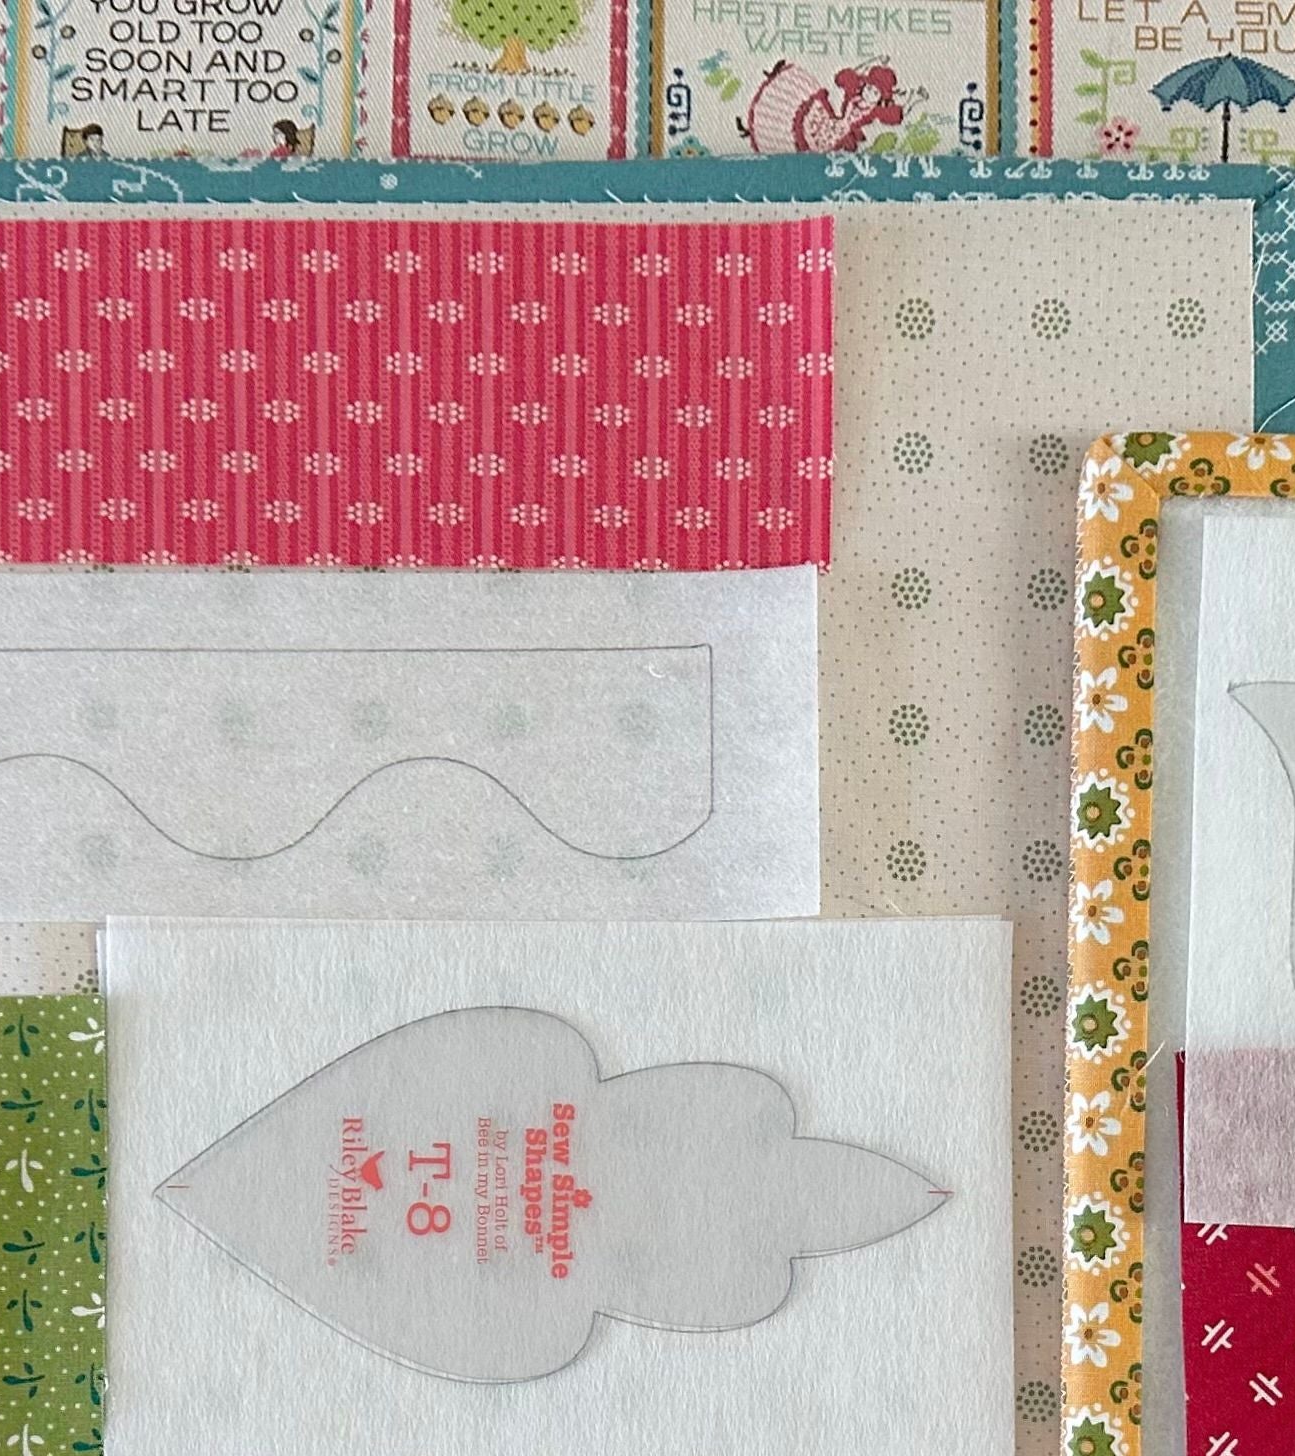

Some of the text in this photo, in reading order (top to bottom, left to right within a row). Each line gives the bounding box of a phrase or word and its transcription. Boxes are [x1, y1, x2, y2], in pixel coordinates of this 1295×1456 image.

[689, 0, 952, 34] HASTE MAKES
[744, 31, 875, 57] WASTE
[1077, 1, 1149, 24] LET
[1181, 1, 1209, 25] A
[1136, 27, 1181, 52] BE
[330, 1117, 368, 1255] Riley Blake
[406, 1142, 451, 1235] T-8
[475, 1117, 491, 1265] Bee in my Bonnet
[494, 1130, 509, 1253] by Lori Holt of
[547, 1103, 575, 1280] Sew Simple
